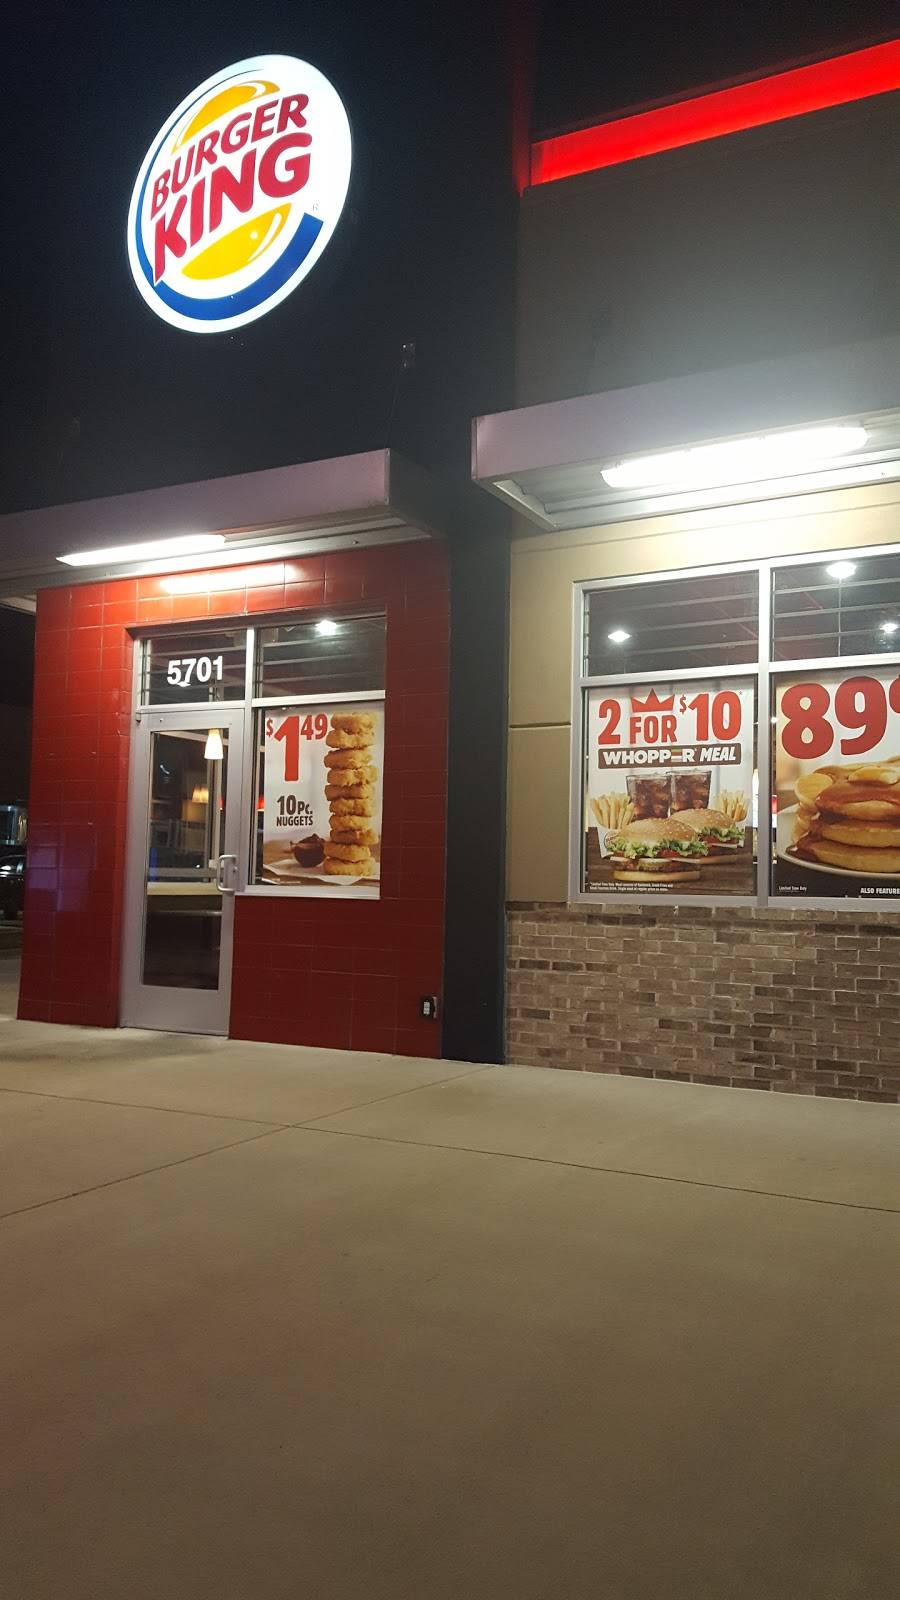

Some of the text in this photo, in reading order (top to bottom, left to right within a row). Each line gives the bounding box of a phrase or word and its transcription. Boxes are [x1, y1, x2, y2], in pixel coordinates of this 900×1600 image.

[150, 93, 309, 220] BURGER
[153, 132, 313, 283] KING
[167, 655, 223, 686] 5701
[598, 699, 621, 745] 2
[630, 715, 677, 744] FOR
[700, 747, 737, 762] MEAL
[276, 816, 314, 826] NUGGETS
